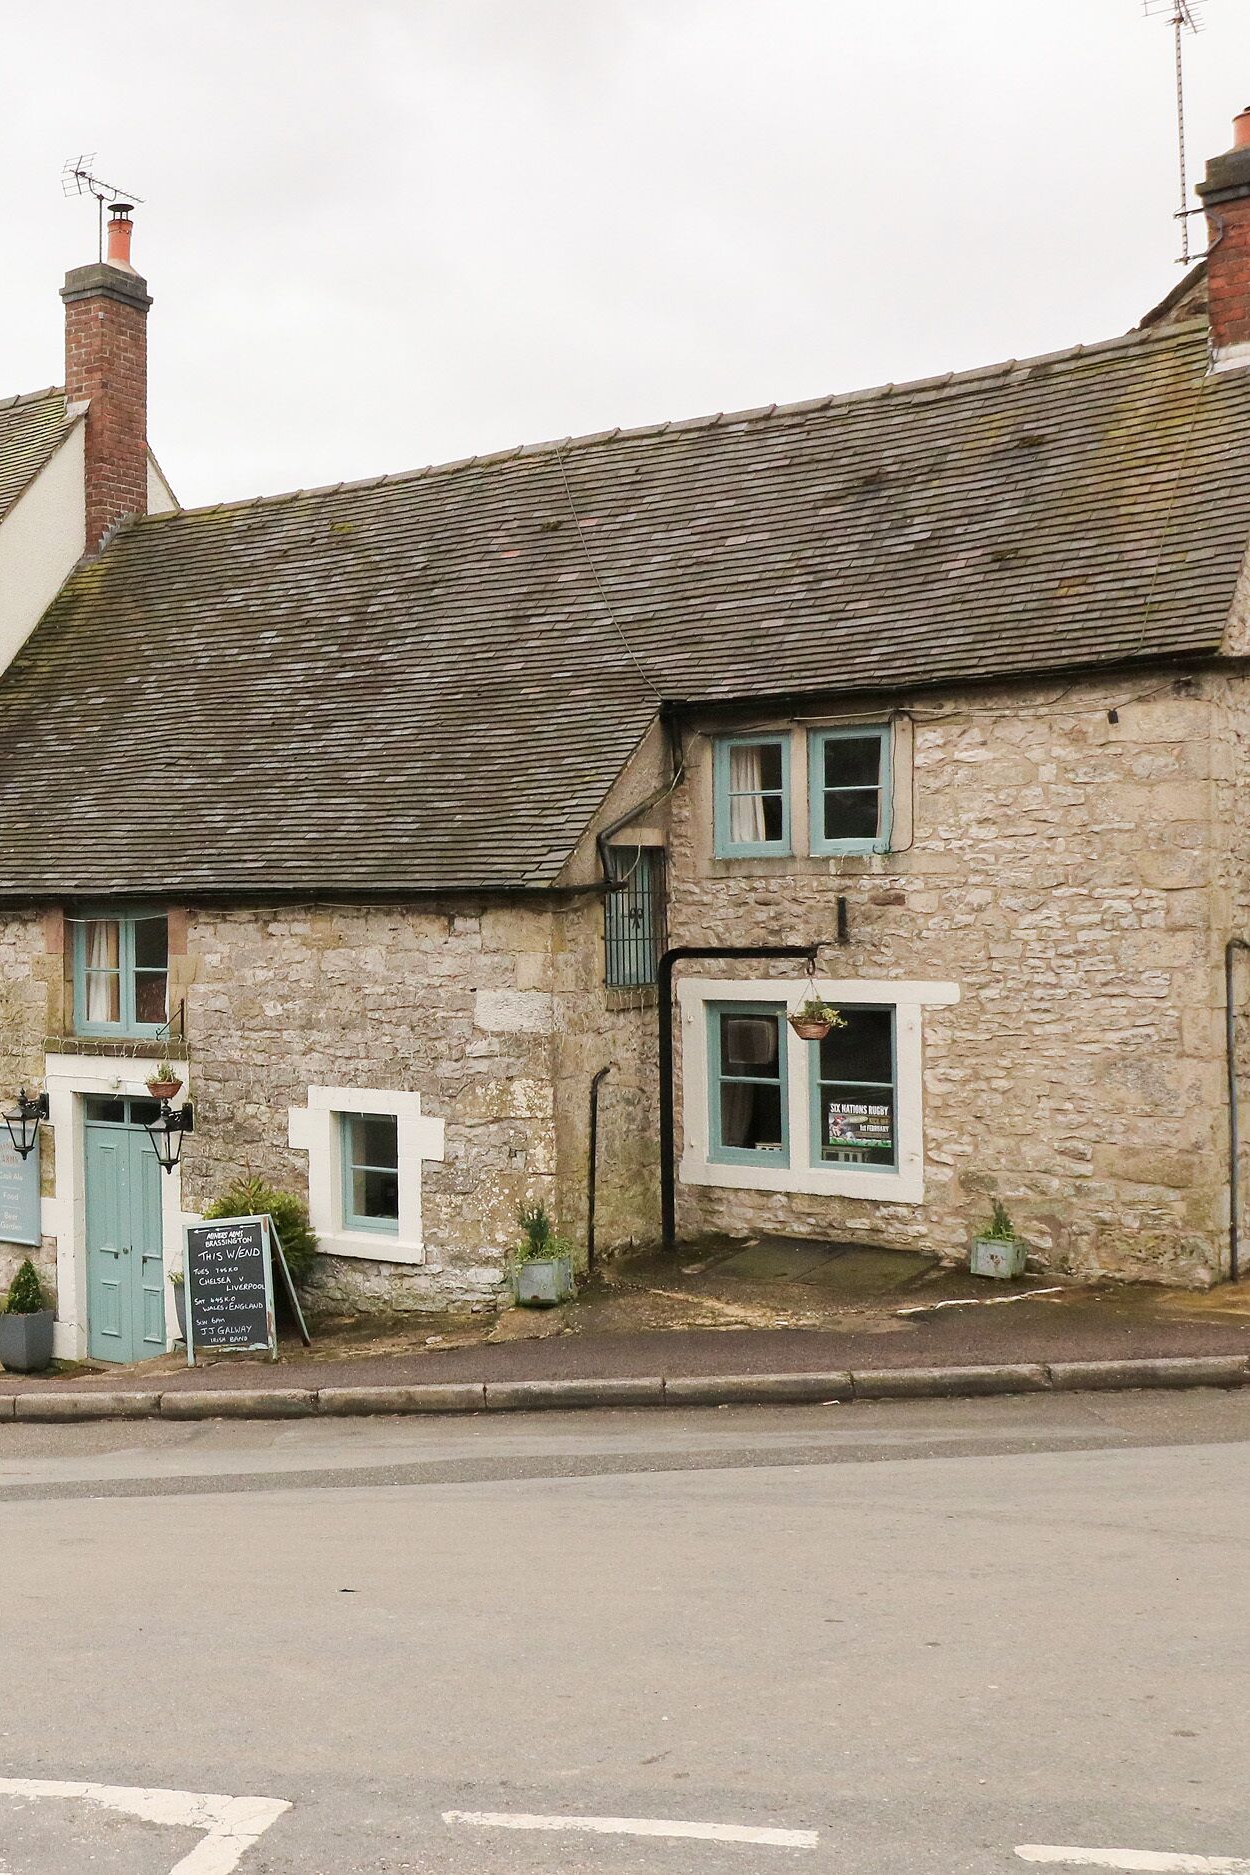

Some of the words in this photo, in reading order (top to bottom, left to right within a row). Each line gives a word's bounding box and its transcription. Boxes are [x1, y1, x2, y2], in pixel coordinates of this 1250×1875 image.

[830, 1103, 841, 1113] SIX
[841, 1104, 868, 1115] NATIONS
[868, 1105, 889, 1116] RUGBY
[3, 1191, 19, 1200] Food
[0, 1221, 22, 1231] Garden
[205, 1236, 252, 1248] BRASSINGTON
[198, 1251, 223, 1261] THIS
[226, 1246, 260, 1260] W/END
[199, 1276, 231, 1286] CHELSEA
[226, 1283, 265, 1291] LIVERPOOL
[229, 1302, 263, 1310] ENGLAND
[217, 1325, 252, 1335] GALWAY
